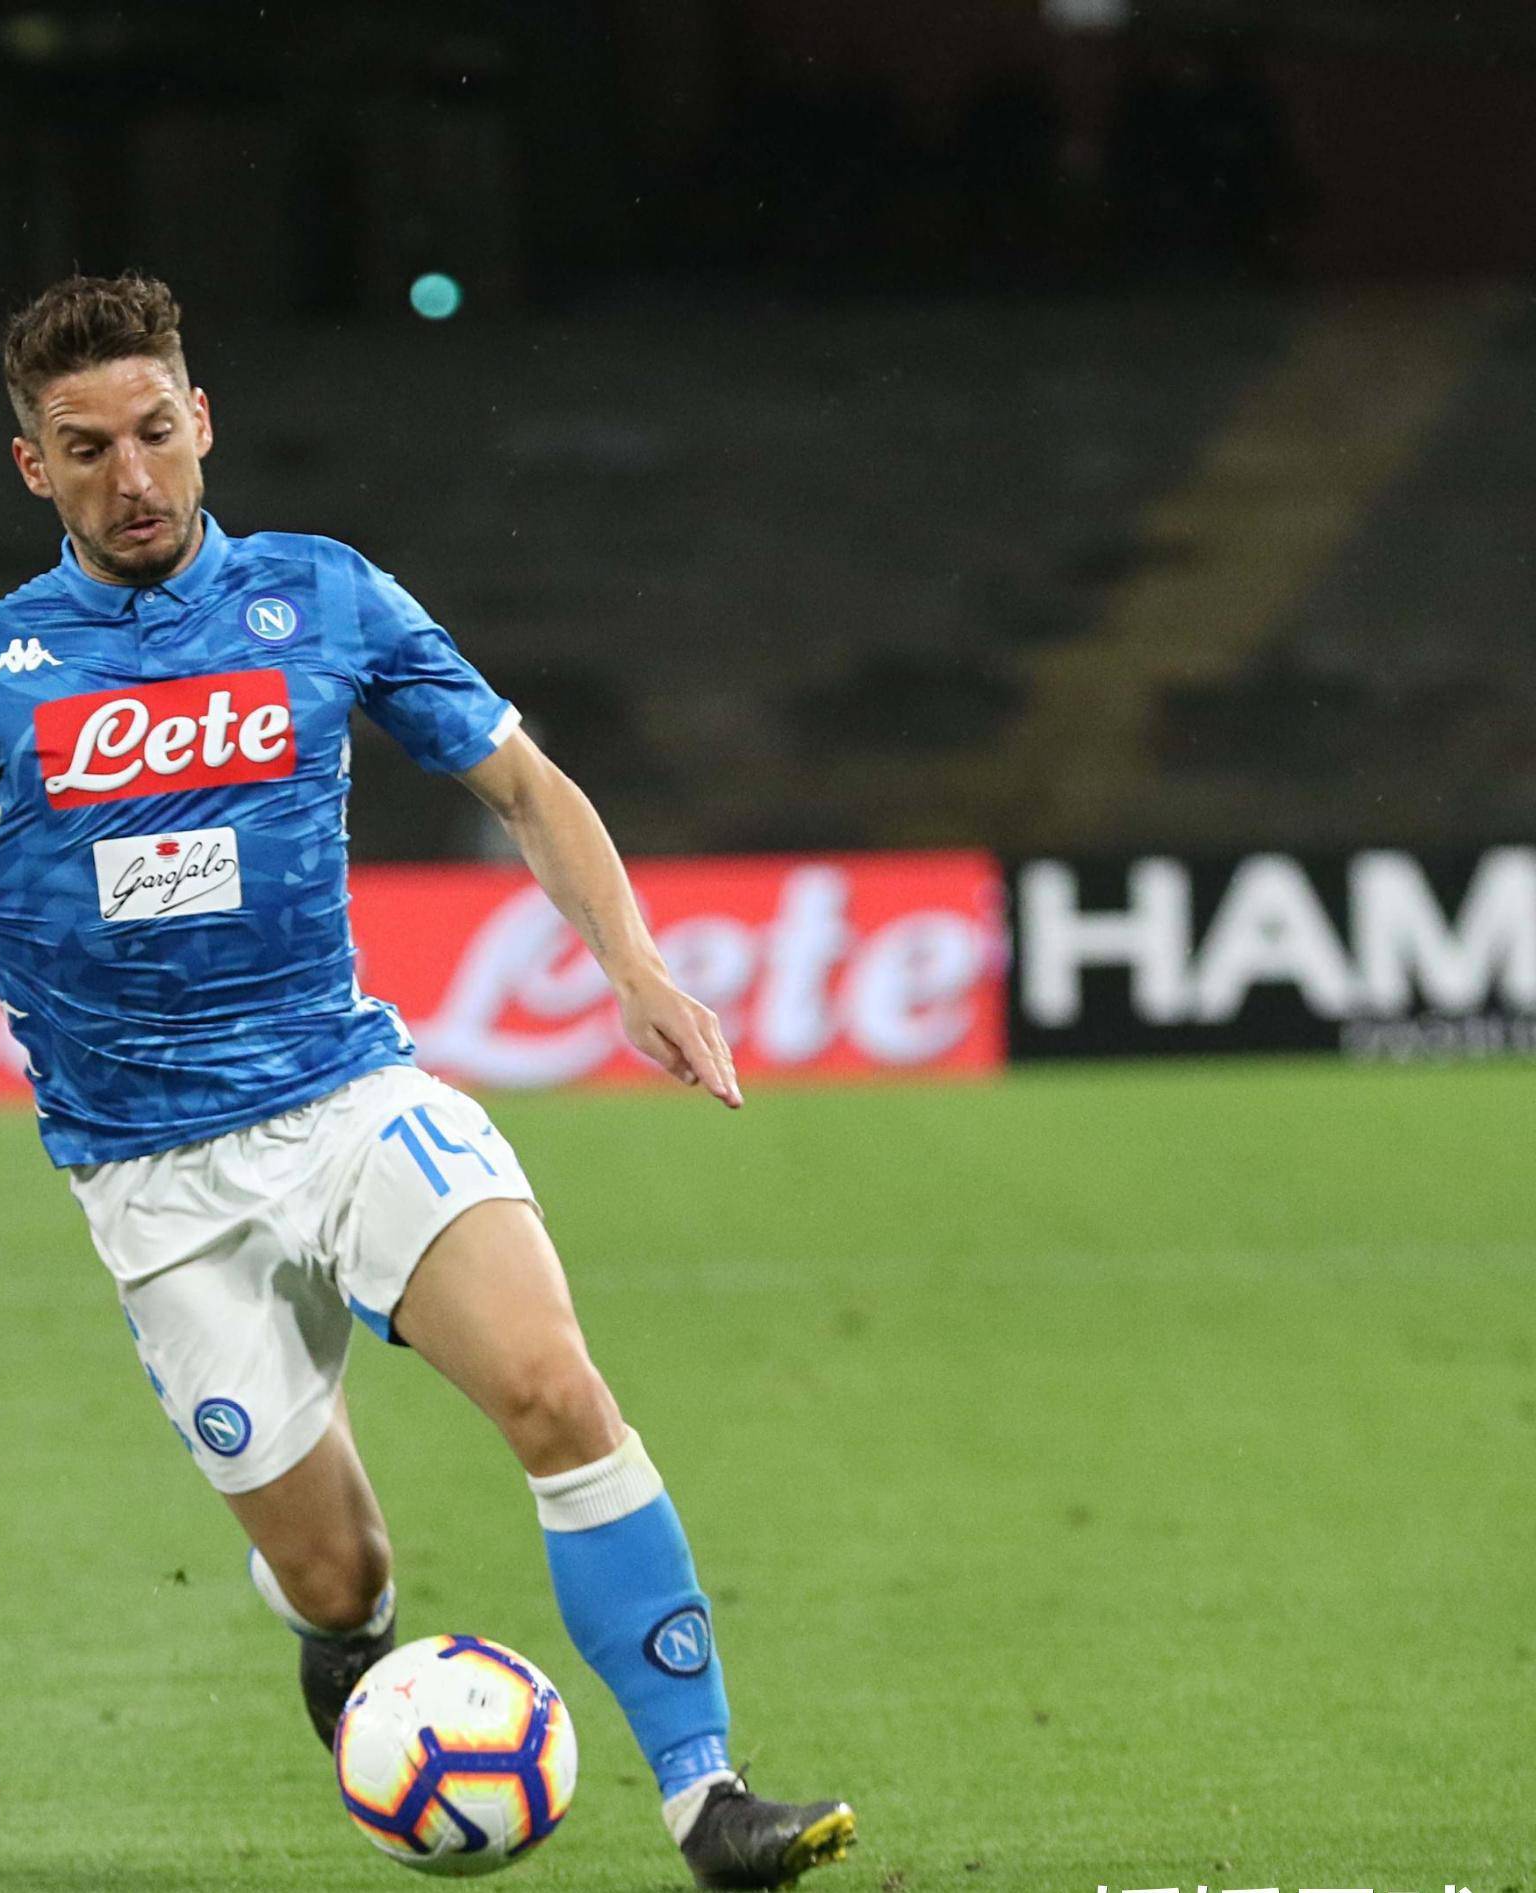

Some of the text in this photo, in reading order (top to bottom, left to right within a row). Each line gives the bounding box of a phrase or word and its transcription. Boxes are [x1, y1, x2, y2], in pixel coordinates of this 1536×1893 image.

[255, 606, 285, 632] N
[45, 690, 290, 795] Lete
[104, 841, 237, 919] Garofalo
[204, 1410, 237, 1445] N
[667, 1621, 699, 1661] N
